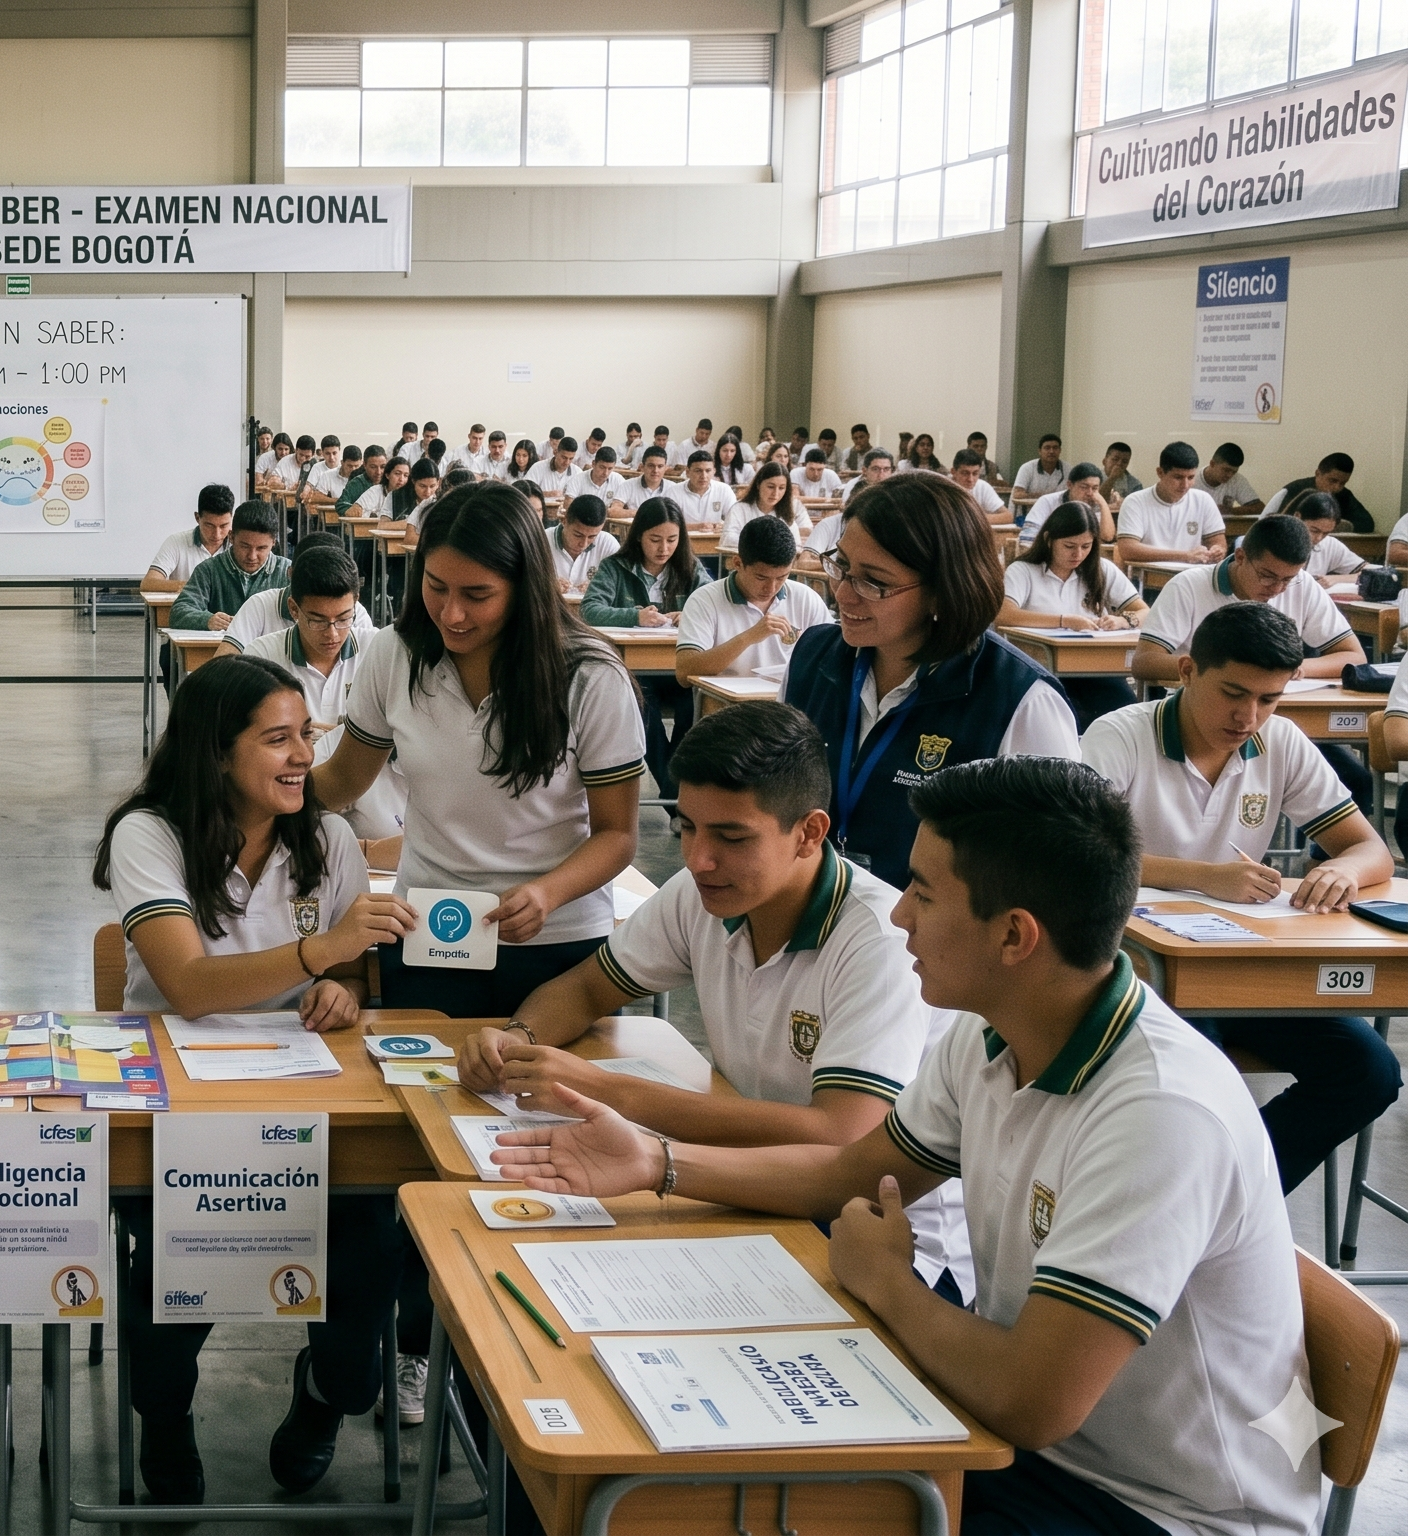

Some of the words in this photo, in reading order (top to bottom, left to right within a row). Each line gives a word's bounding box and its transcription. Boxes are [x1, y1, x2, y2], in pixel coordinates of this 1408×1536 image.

[1099, 126, 1218, 184] Cultivando
[1227, 90, 1396, 159] Habilidades
[1153, 180, 1189, 222] del
[1197, 161, 1305, 216] Corazón
[95, 196, 221, 224] EXAMEN
[233, 196, 388, 224] NACIONAL
[72, 229, 195, 264] BOGOTÁ
[1207, 267, 1277, 299] Silencio
[37, 320, 124, 345] SABER:
[41, 361, 89, 385] 1:00
[100, 365, 126, 384] PM
[1336, 716, 1359, 726] 209
[1326, 971, 1365, 989] 309
[40, 1124, 76, 1140] icfes
[262, 1125, 297, 1140] icfes
[164, 1166, 319, 1188] Comunicación
[195, 1192, 287, 1212] Asertiva
